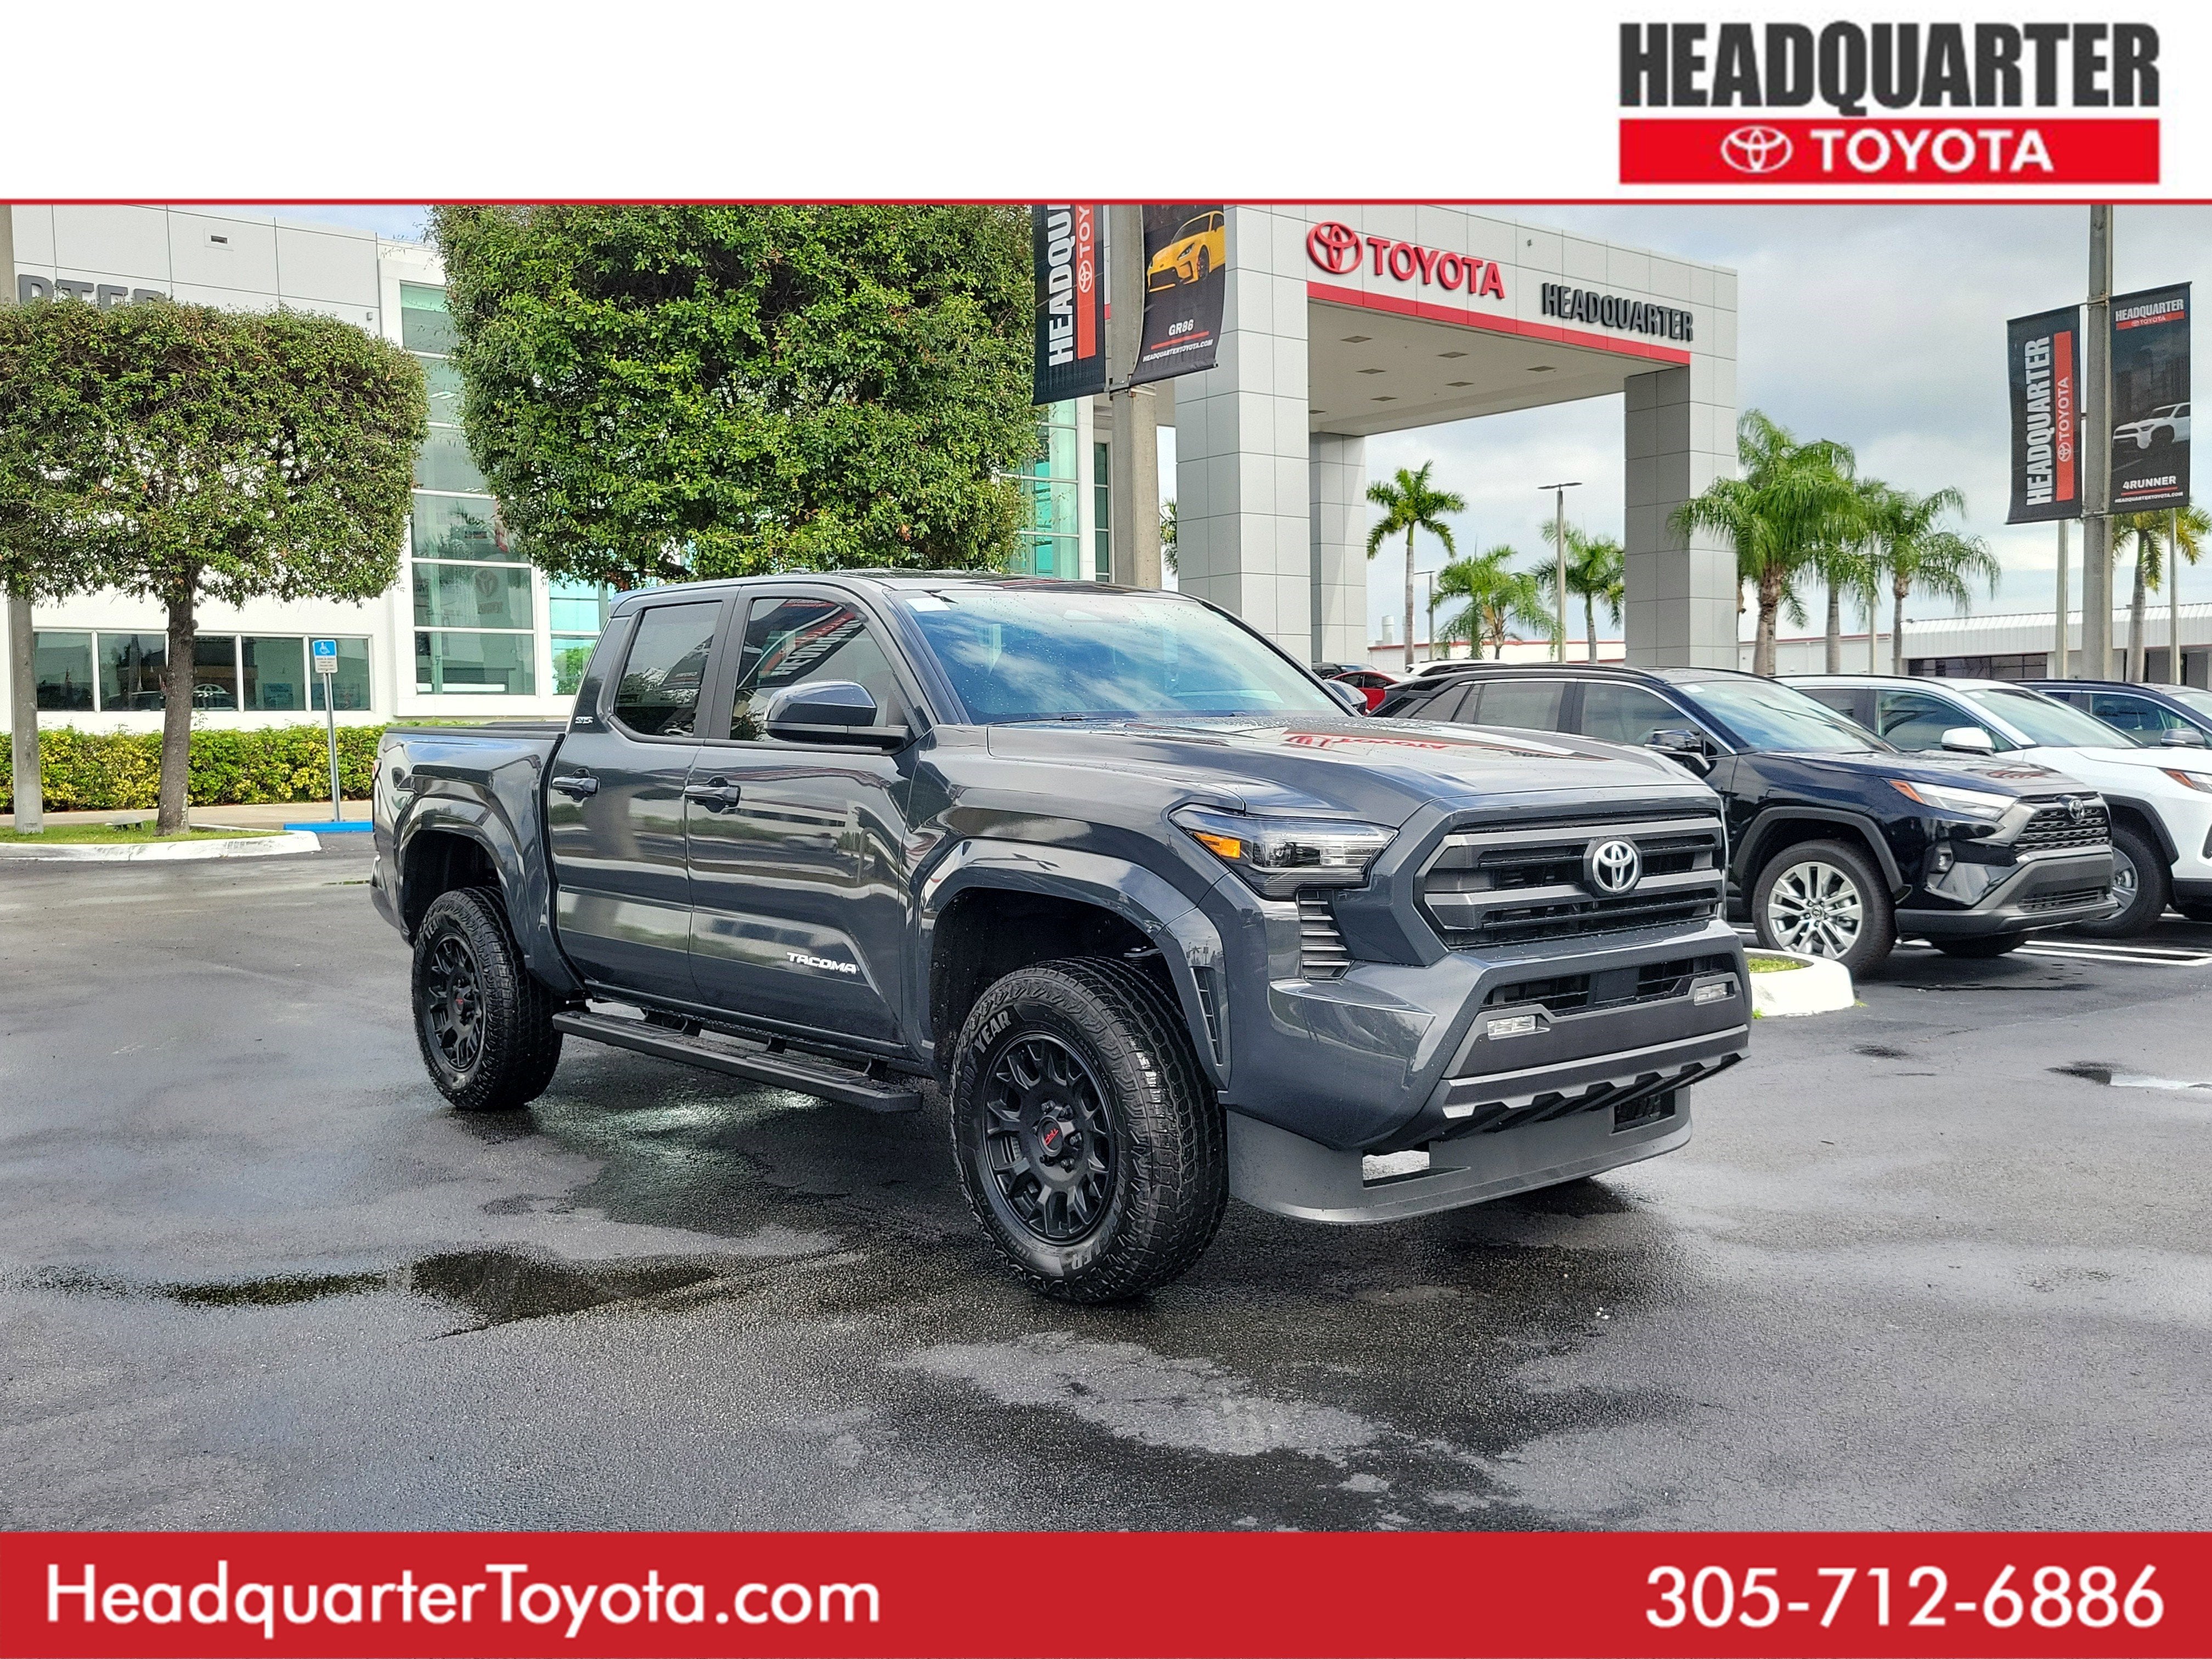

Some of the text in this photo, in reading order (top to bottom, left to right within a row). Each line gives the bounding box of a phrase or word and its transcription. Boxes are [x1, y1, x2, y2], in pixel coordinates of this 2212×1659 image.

[1367, 237, 1505, 299] TOYOTA
[1047, 205, 1075, 366] HEADQU
[1542, 283, 1693, 341] HEADQUARTER
[2115, 298, 2183, 321] HEADQUARTER
[2140, 316, 2166, 326] TOYOTA
[1168, 319, 1194, 336] GR86
[1142, 338, 1214, 363] HEADQUARTERTOYOTA.COM
[2024, 336, 2055, 506] HEADQUARTER
[2057, 376, 2070, 442] TOYOTA
[2122, 475, 2176, 489] 4RUNNER
[787, 952, 857, 974] TACOMA
